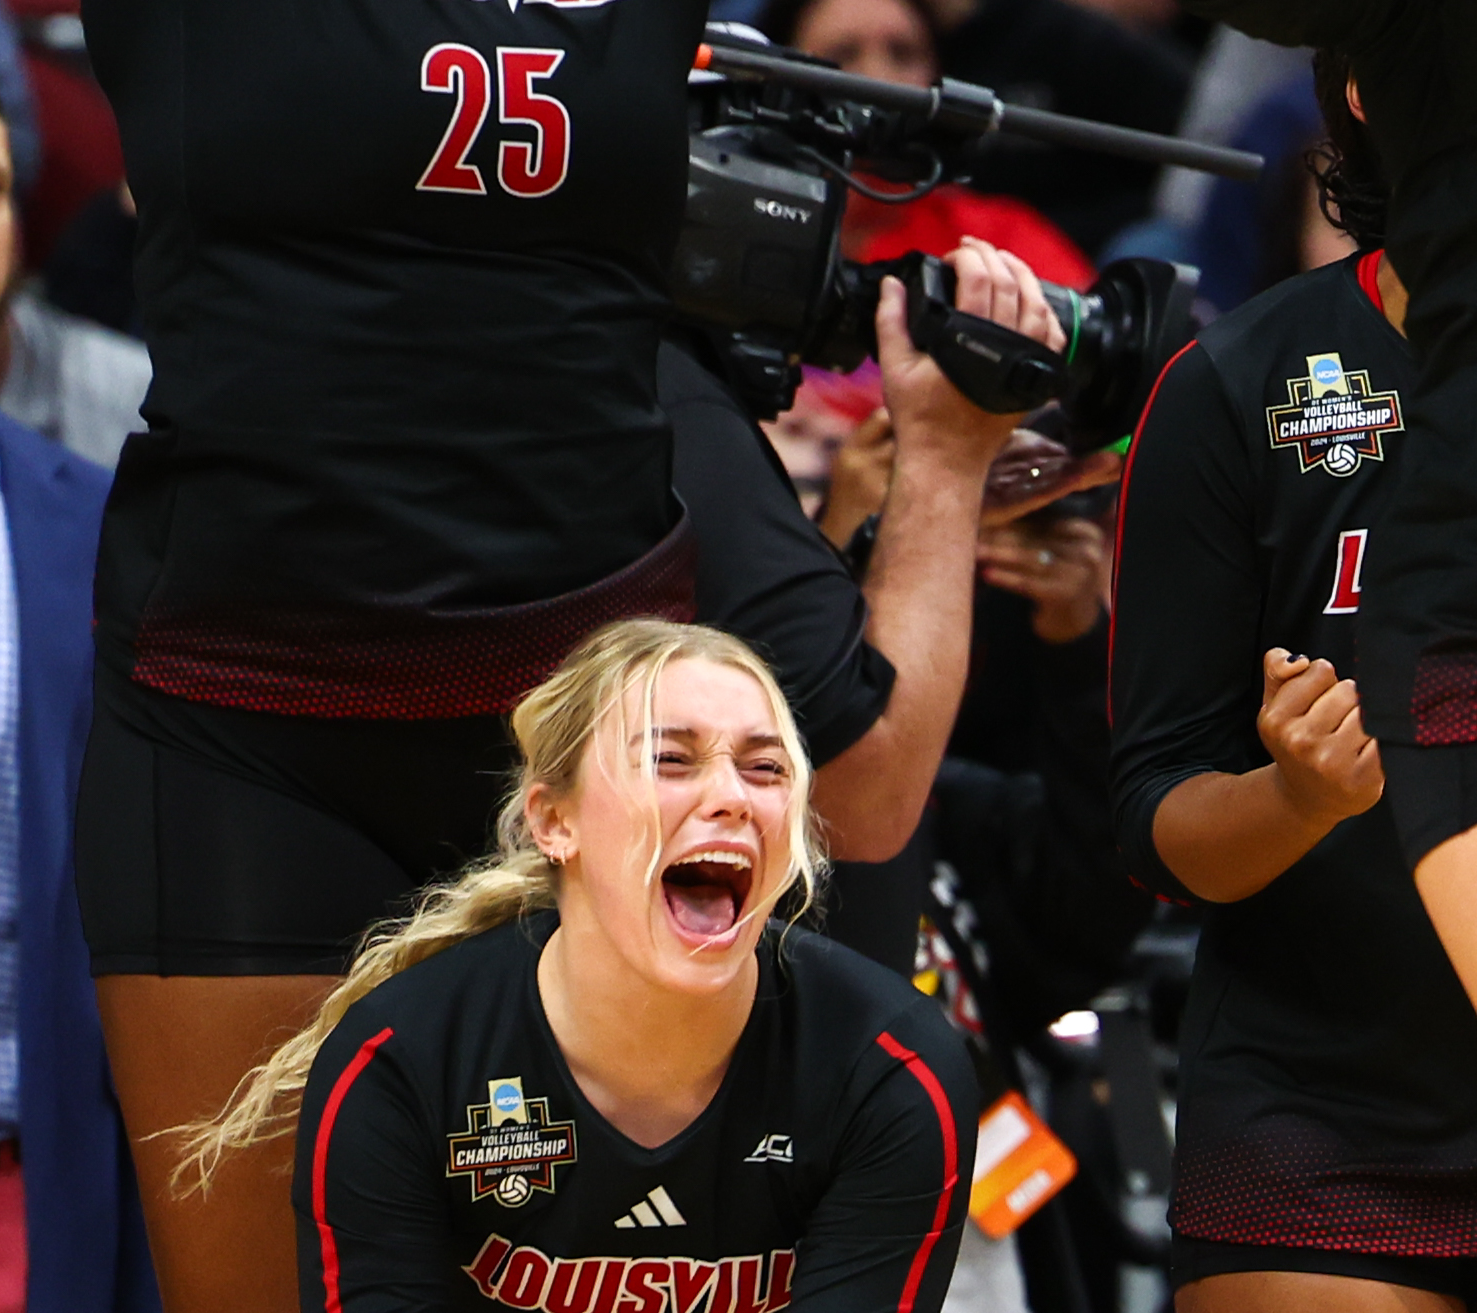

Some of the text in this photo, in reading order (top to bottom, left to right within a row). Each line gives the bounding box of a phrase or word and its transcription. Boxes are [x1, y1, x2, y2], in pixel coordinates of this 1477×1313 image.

[416, 43, 570, 197] 25
[754, 197, 811, 223] SONY
[1280, 408, 1391, 438] CHAMPIONSHIP
[1304, 400, 1363, 419] VOLLEYBALL
[456, 1138, 567, 1166] CHAMPIONSHIP
[481, 1130, 539, 1147] VOLLEYBALL
